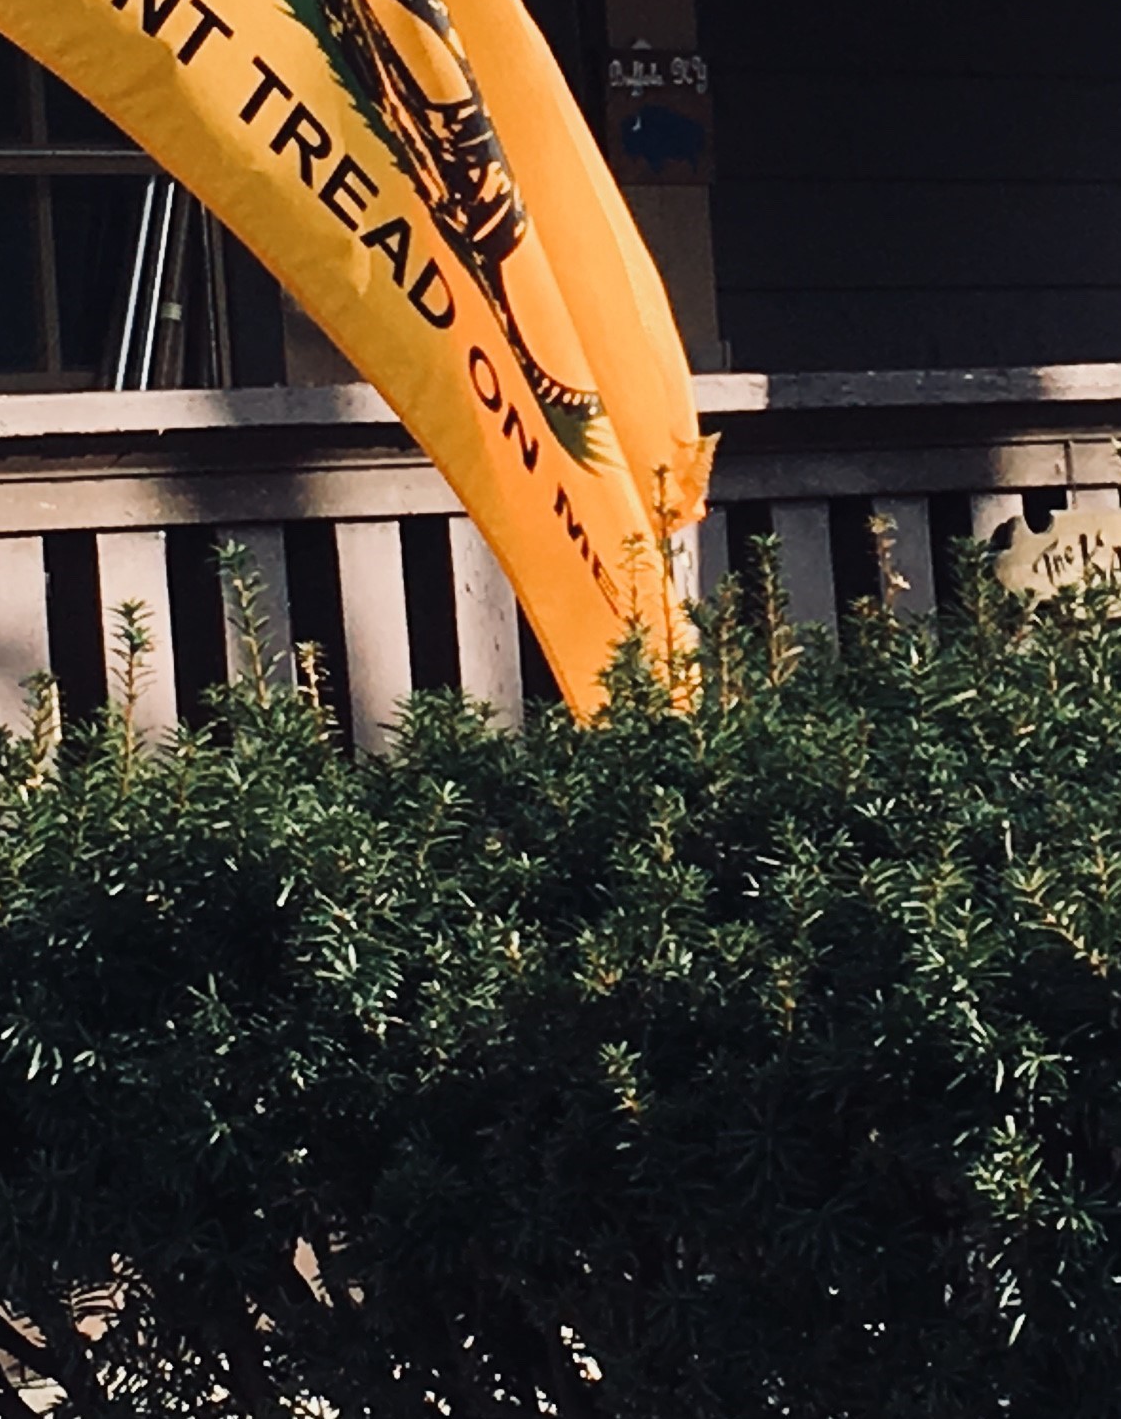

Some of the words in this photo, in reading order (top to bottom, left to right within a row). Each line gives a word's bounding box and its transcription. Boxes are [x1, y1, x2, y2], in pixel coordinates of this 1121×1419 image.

[238, 55, 457, 330] TREAD
[469, 345, 539, 474] ON
[553, 482, 620, 617] ME
